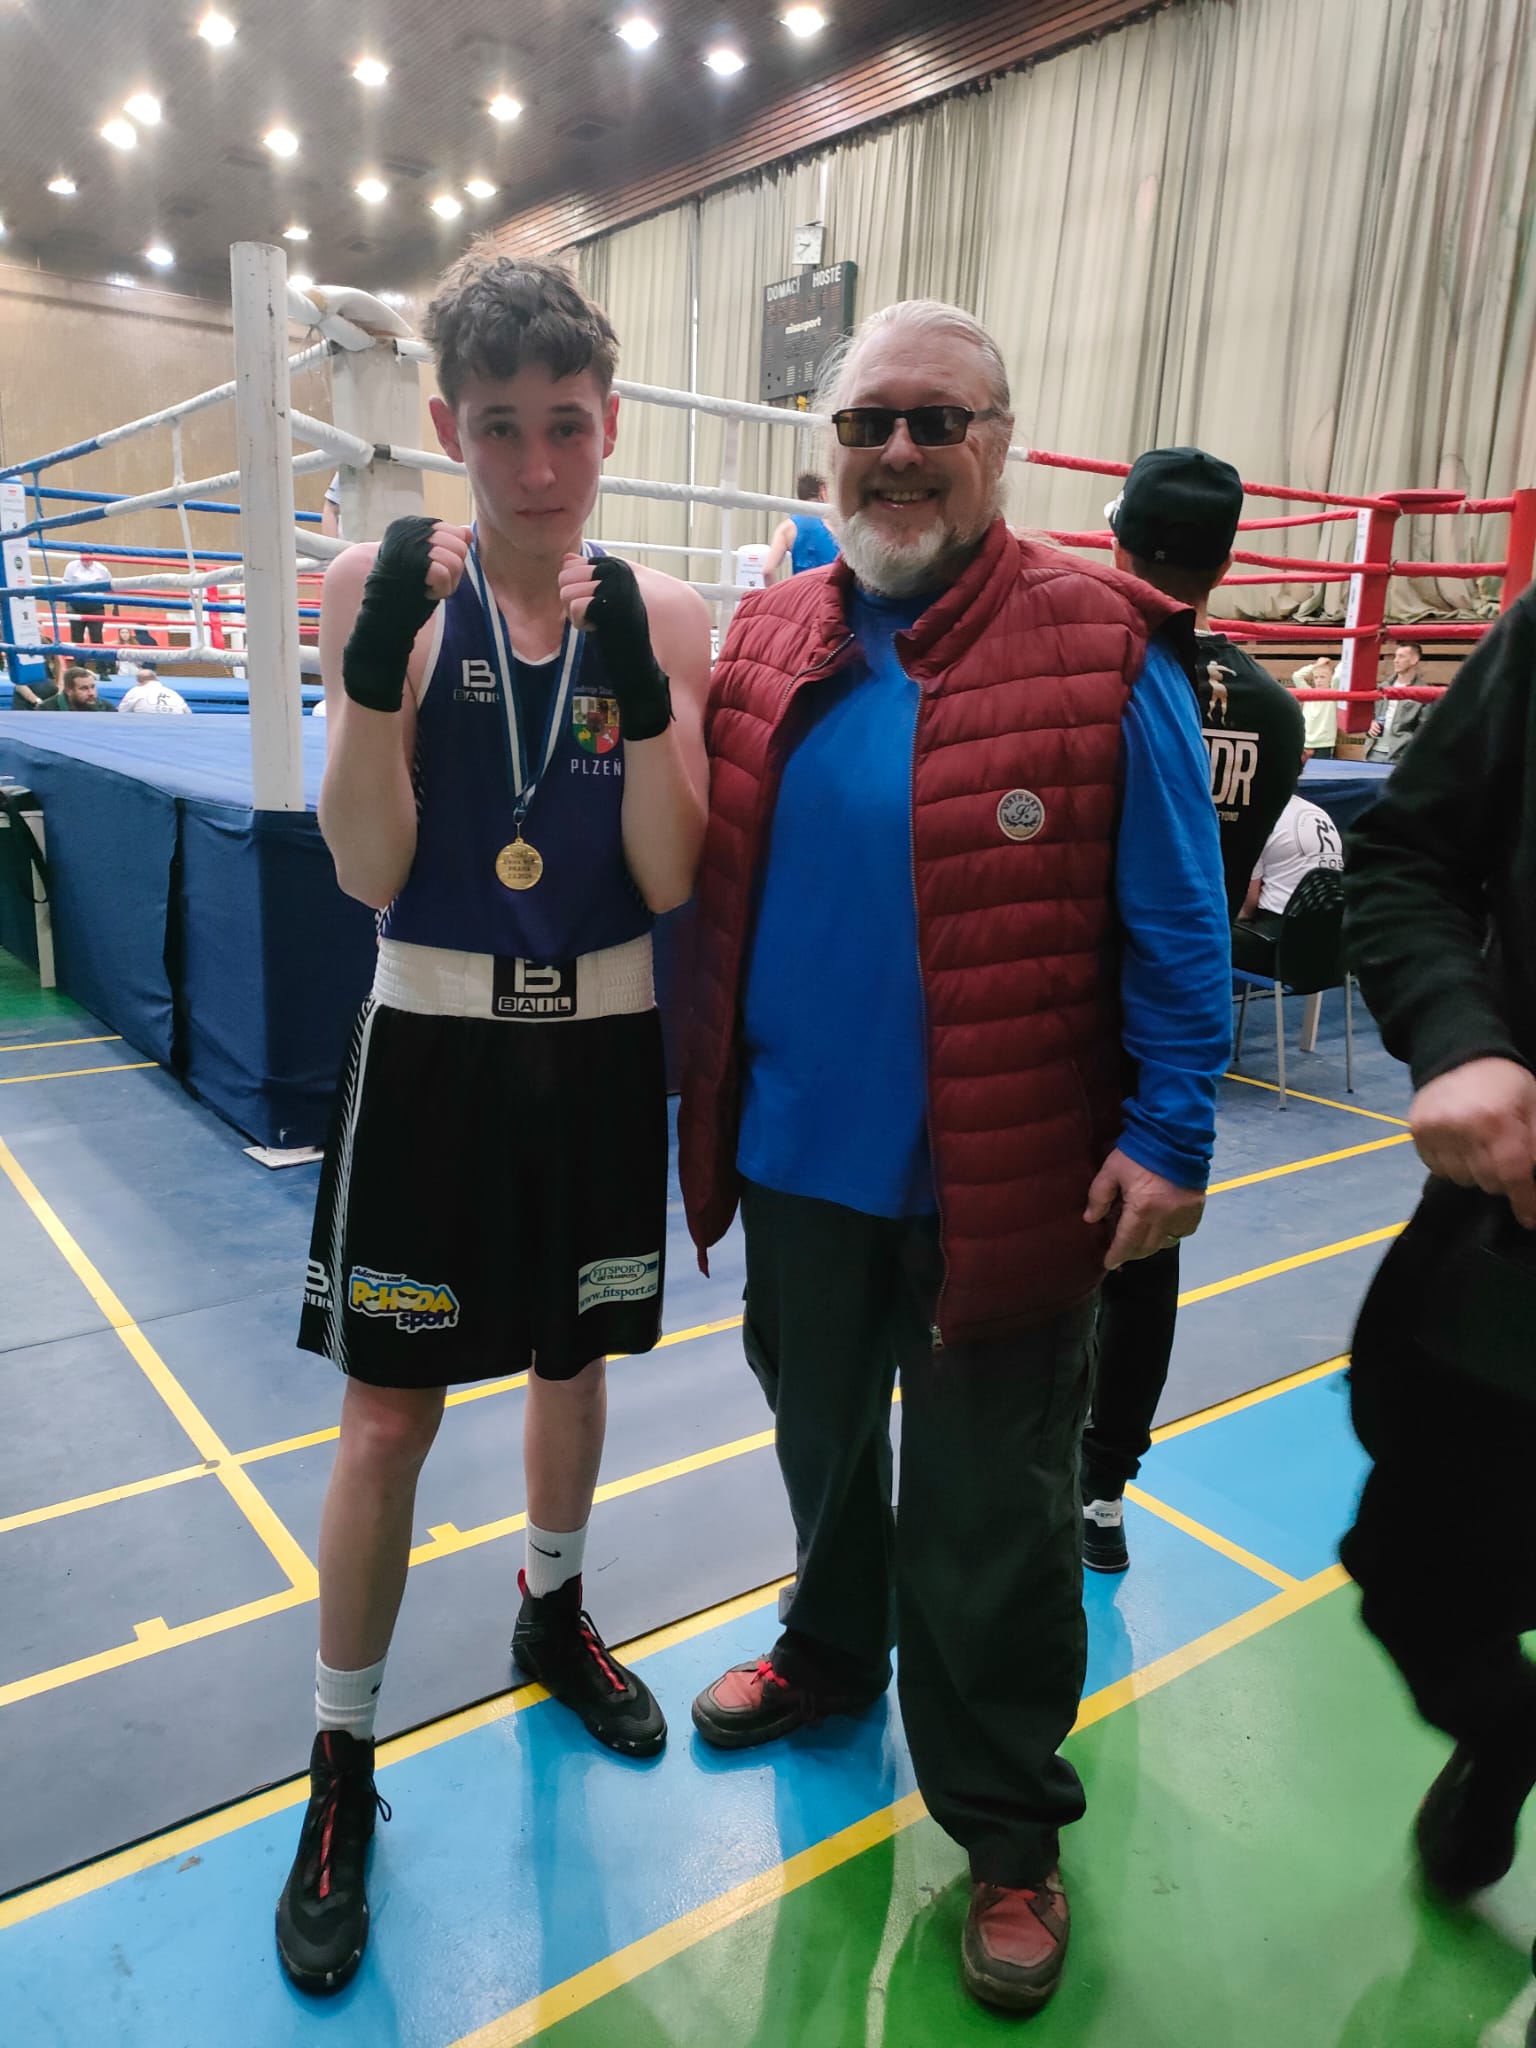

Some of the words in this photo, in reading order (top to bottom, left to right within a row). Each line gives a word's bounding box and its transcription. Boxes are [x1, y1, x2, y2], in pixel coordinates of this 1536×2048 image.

[570, 758, 622, 776] PLZEŇ
[1202, 738, 1258, 806] DR
[498, 996, 571, 1012] BAIL
[592, 1264, 642, 1278] FITSPORT
[352, 1280, 455, 1313] POHODA
